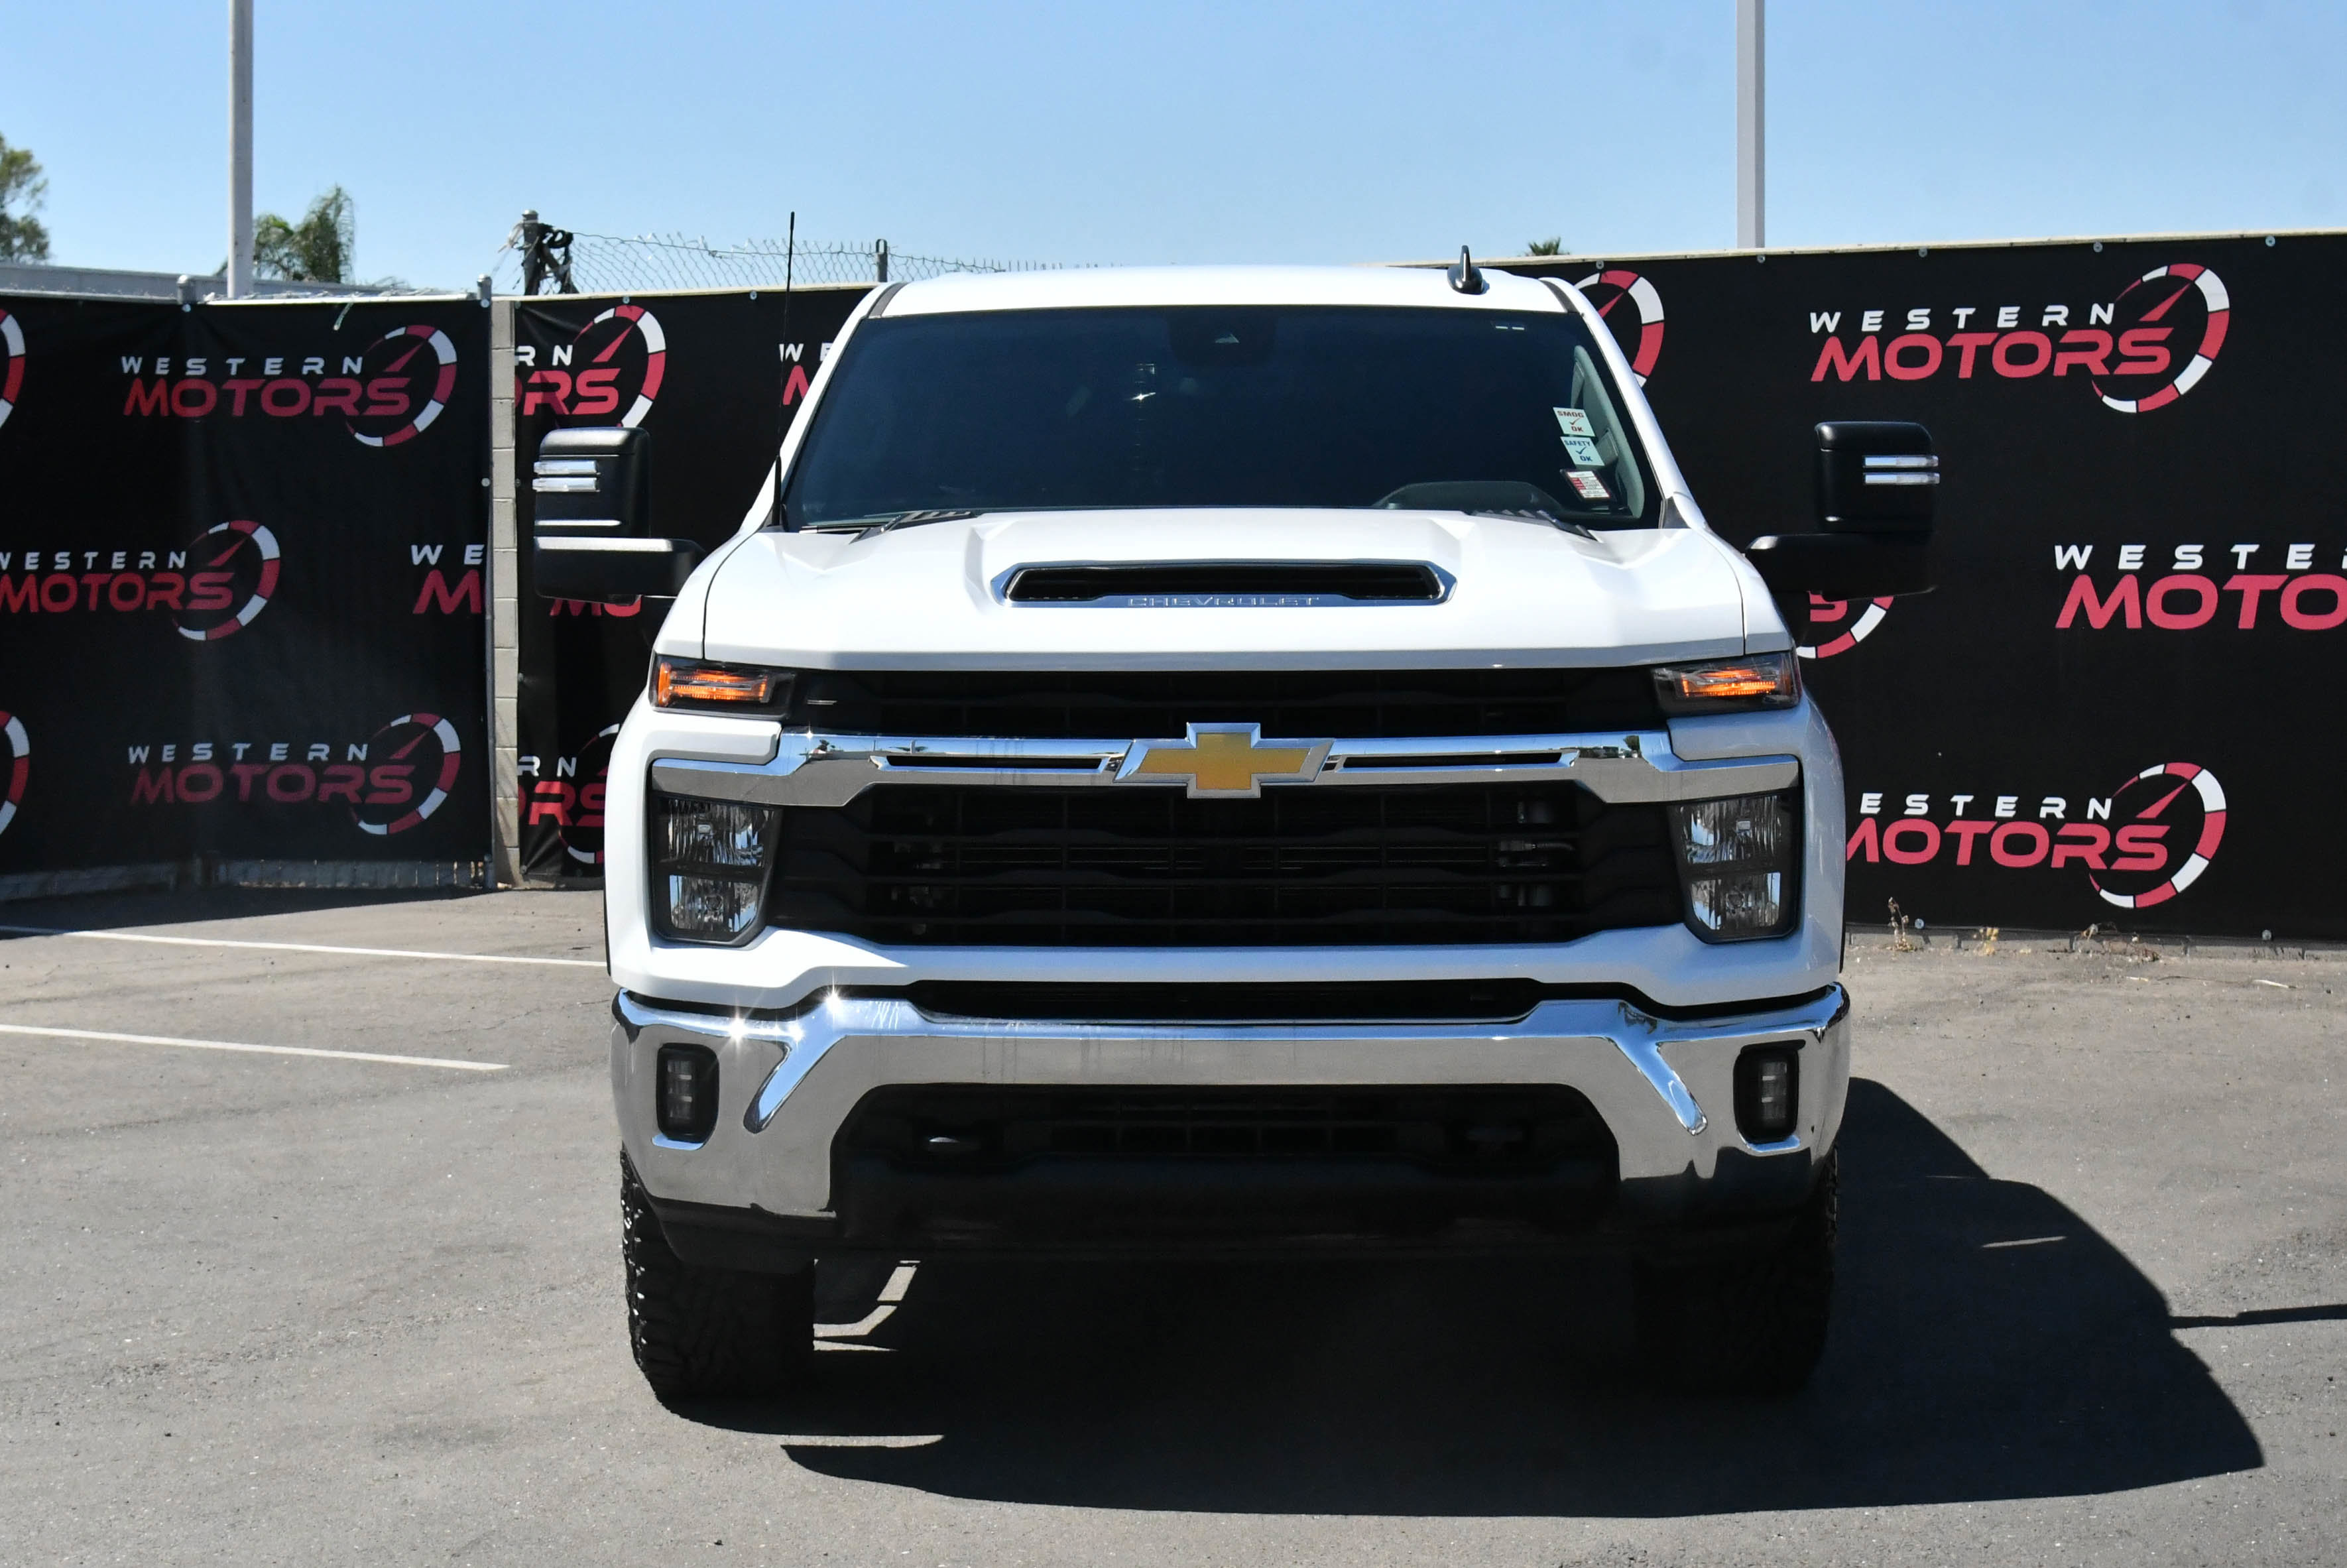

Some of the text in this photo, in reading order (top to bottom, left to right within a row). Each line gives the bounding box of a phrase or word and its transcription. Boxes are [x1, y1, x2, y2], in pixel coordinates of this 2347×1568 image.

[1809, 302, 2114, 333] WESTERN
[121, 356, 363, 375] WESTERN
[1811, 327, 2175, 383] MOTORS
[123, 377, 412, 418] MOTORS
[2054, 543, 2347, 571] WESTE
[0, 572, 235, 614] MOTORS
[1128, 596, 1319, 607] CHEVROLET
[2055, 573, 2347, 631] MOTO
[128, 743, 369, 764] WESTERN
[131, 764, 416, 805] MOTORS
[1859, 792, 2112, 821] ESTERN
